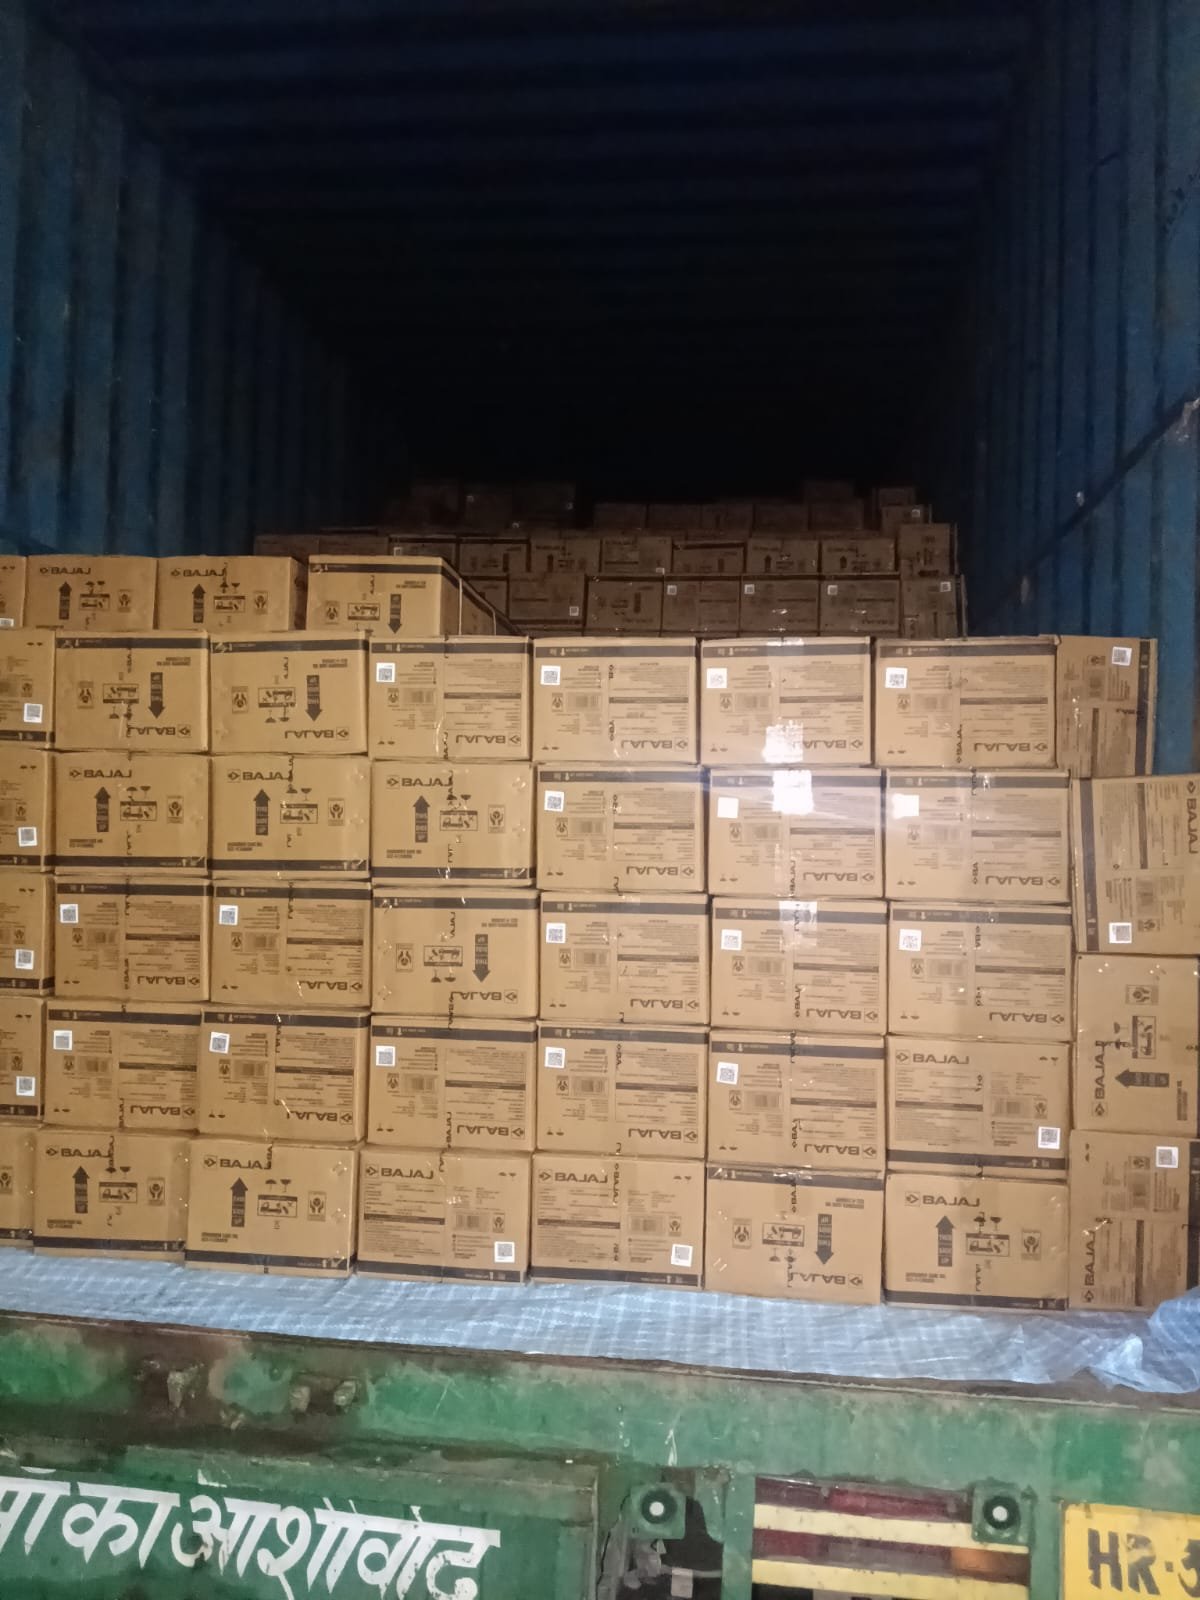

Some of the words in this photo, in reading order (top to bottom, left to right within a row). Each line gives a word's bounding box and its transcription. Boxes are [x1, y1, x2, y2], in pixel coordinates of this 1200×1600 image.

[50, 567, 91, 575] BAJAJ
[183, 568, 226, 577] BAJAJ
[128, 726, 176, 736] BAJAJ
[284, 729, 334, 738] BAJAJ
[455, 734, 506, 744] BAJAJ
[621, 739, 673, 749] BAJAJ
[793, 739, 847, 749] BAJA
[974, 742, 1031, 752] BAJAJ
[84, 769, 132, 778] BAJAJ
[243, 771, 292, 781] BAJAJ
[402, 777, 453, 787] BAJAJ
[1187, 798, 1198, 855] BAJAJ
[626, 866, 679, 876] BAJAJ
[803, 871, 858, 882] BAJAJ
[985, 876, 1043, 887] BAJAJ
[137, 975, 186, 985] BAJAJ
[300, 980, 348, 991] BAJAJ
[451, 991, 502, 1001] BAJAJ
[630, 998, 683, 1010] BAJAJ
[806, 1007, 862, 1019] BAJAJ
[989, 1012, 1047, 1023] BAJAJ
[912, 1053, 969, 1064] BAJAJ
[1095, 1040, 1105, 1099] BAJAJ
[130, 1105, 180, 1116] BAJAJ
[287, 1111, 337, 1122] BAJAJ
[456, 1125, 509, 1137] BAJAJ
[628, 1128, 682, 1140] BAJAJ
[61, 1147, 110, 1158] BAJAJ
[804, 1144, 860, 1156] BAJAJ
[219, 1158, 271, 1169] BAJAJ
[380, 1168, 434, 1179] BAJAJ
[554, 1172, 608, 1184] BAJAJ
[922, 1195, 980, 1207] BAJAJ
[1084, 1229, 1096, 1286] BAJAJ
[791, 1272, 846, 1285] BAJAJ
[62, 1481, 181, 1569] का
